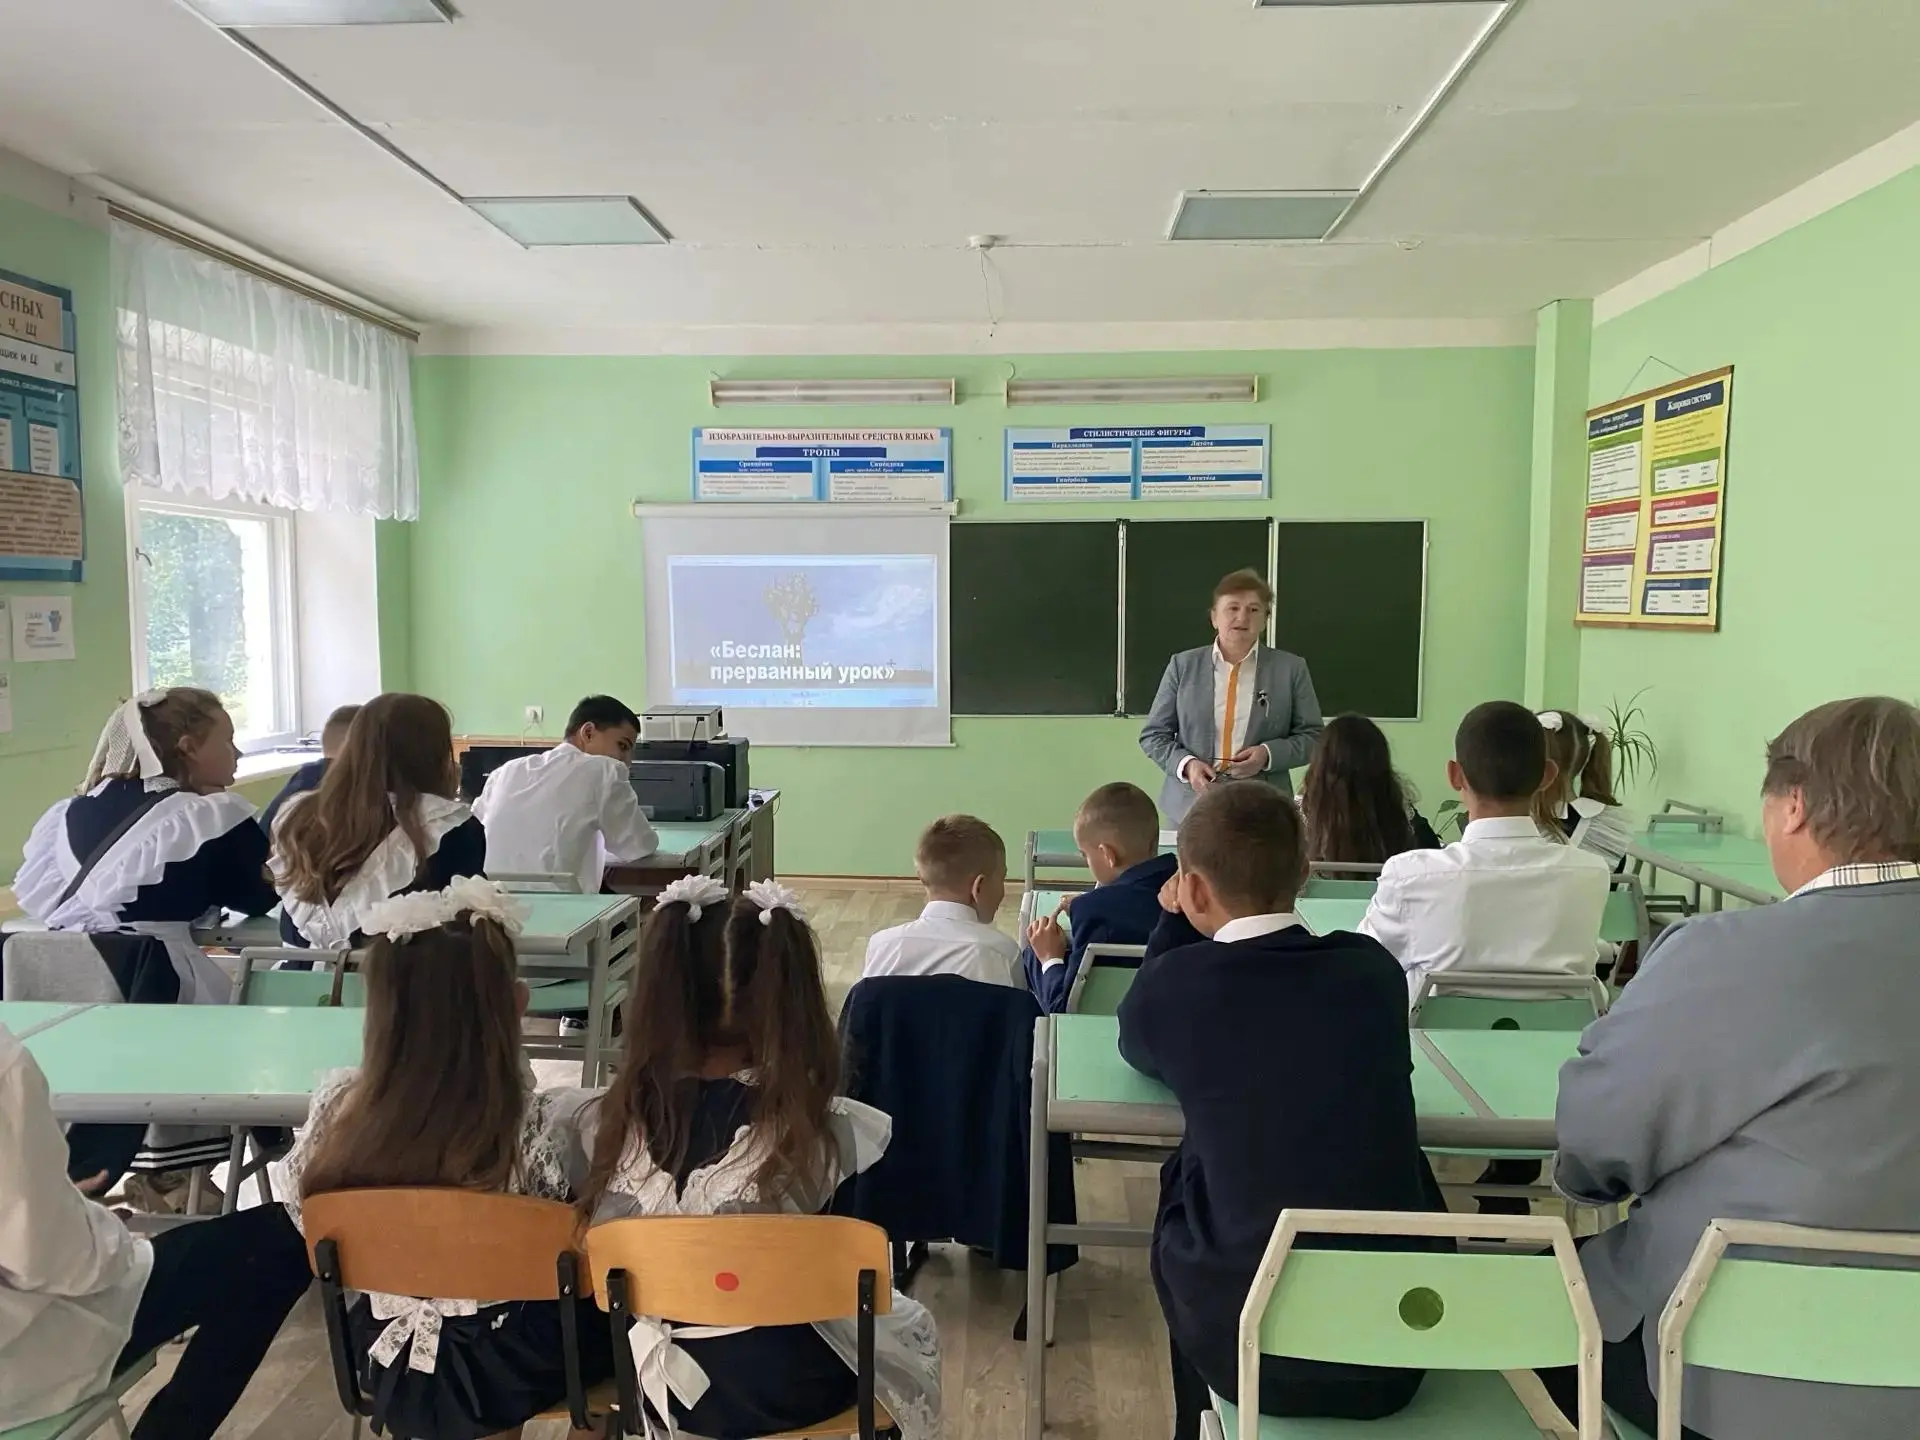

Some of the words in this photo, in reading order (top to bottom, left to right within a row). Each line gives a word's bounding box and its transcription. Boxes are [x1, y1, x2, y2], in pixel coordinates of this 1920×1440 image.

[862, 432, 903, 441] СРЕДСТВА
[905, 432, 934, 440] ЯЗЫКА
[1083, 430, 1156, 438] СТИЛИСТИЧЕСКИЕ
[1157, 429, 1191, 437] ФИГУРЫ
[802, 448, 840, 457] ТРОПЫ
[710, 641, 801, 659] «Беслан:
[710, 661, 833, 683] прерванный
[838, 665, 895, 684] урок»
